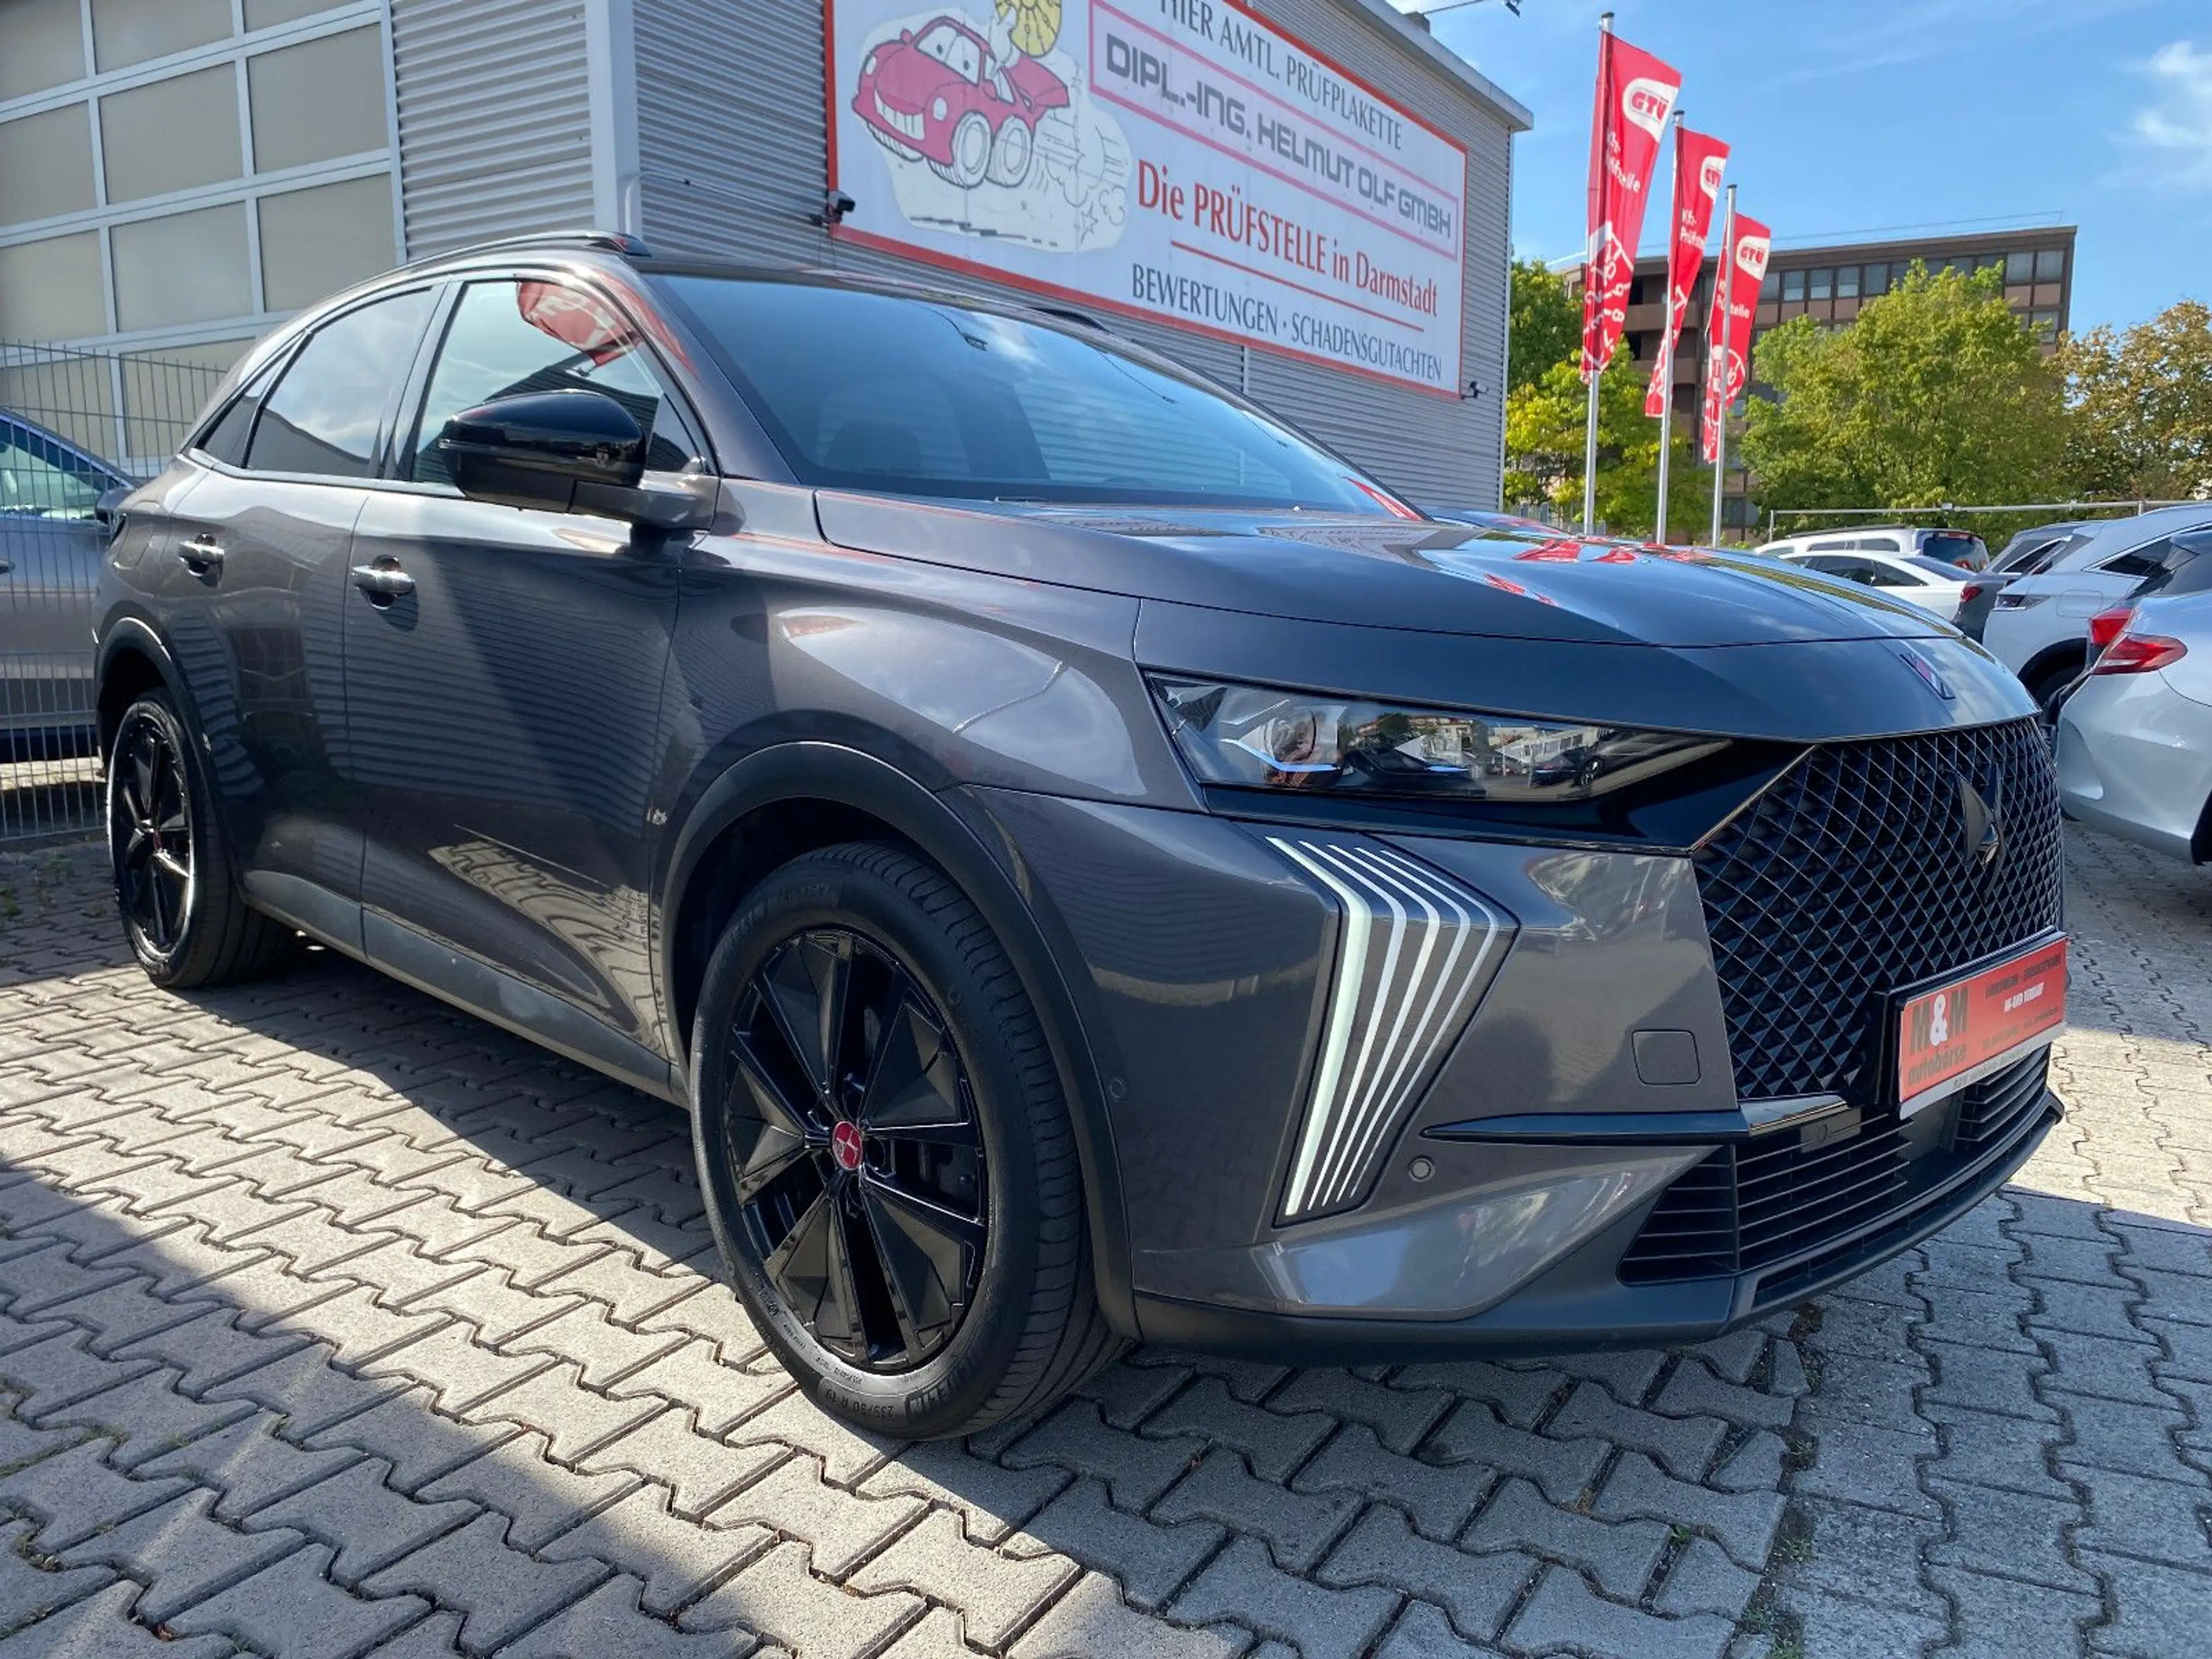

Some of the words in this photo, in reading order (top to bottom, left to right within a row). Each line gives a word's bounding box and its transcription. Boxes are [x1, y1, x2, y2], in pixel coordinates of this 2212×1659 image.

[1107, 33, 1251, 139] DIPL.-ING.
[1258, 112, 1354, 188] HELMUT
[1358, 166, 1395, 207] OLF
[1399, 189, 1451, 238] GMBH
[1219, 16, 1279, 80] AMTL.
[1287, 55, 1402, 150] PRÜFPLAKETTE
[1138, 160, 1184, 220] Die
[1195, 183, 1326, 274] PRÜFSTELLE
[1333, 239, 1349, 283] in
[1356, 251, 1437, 317] Darmstadt
[1132, 263, 1278, 336] BEWERTUNGEN
[1292, 312, 1441, 381] SCHADENSGUTACHTEN
